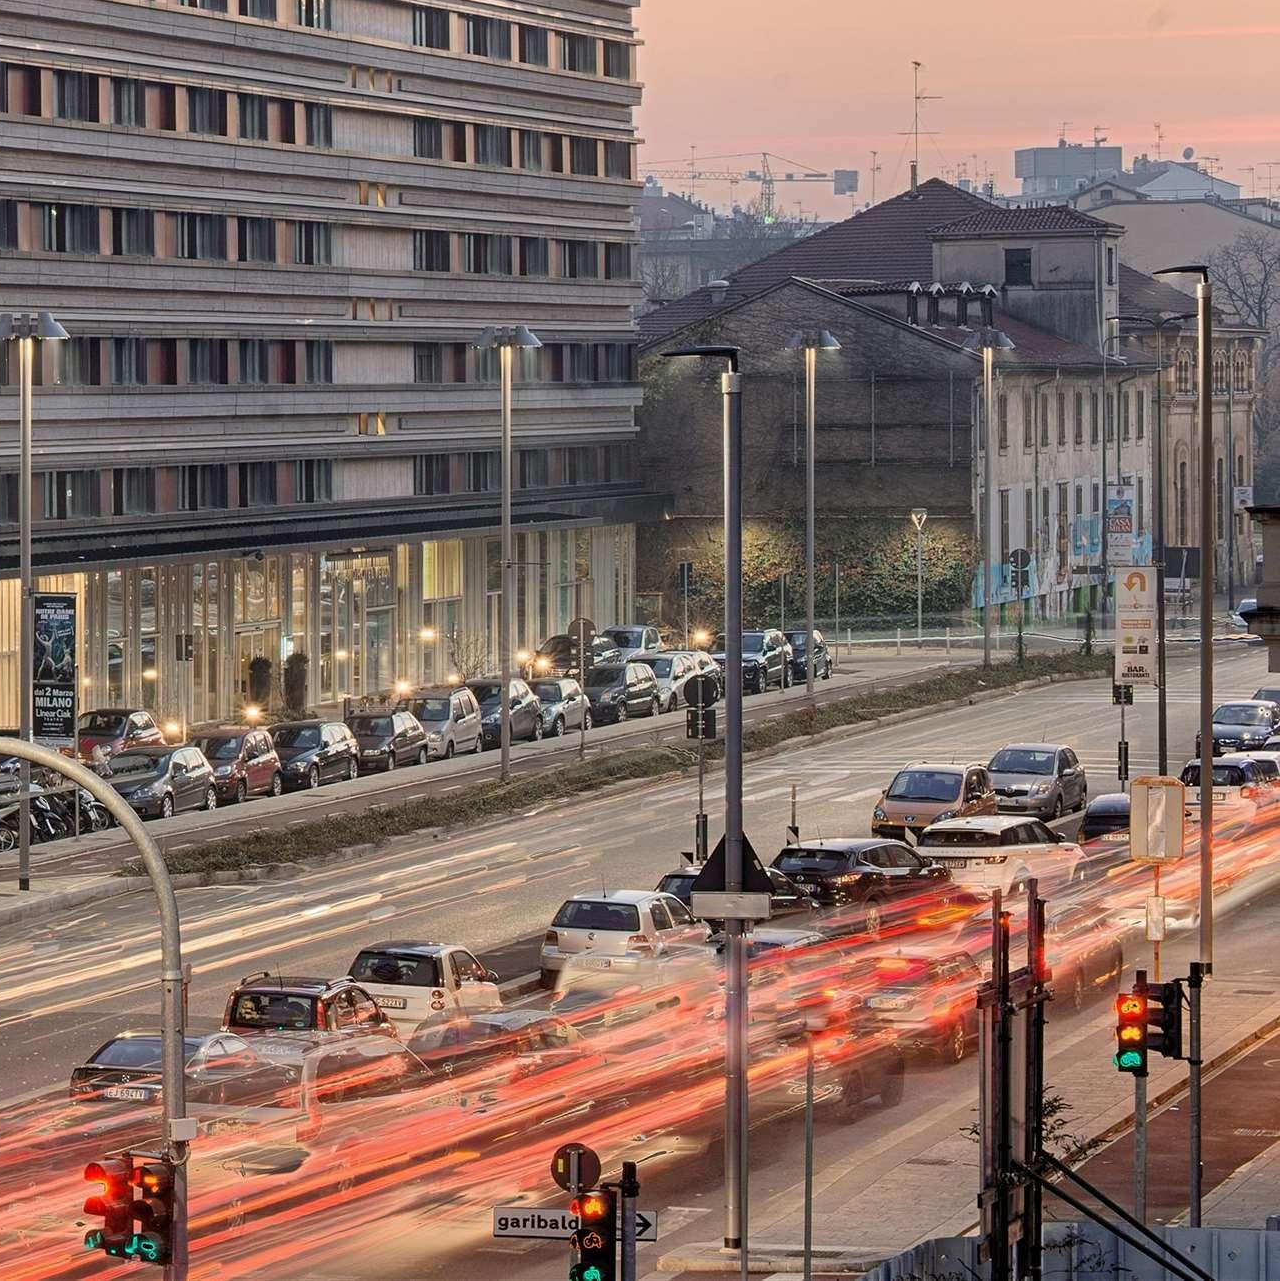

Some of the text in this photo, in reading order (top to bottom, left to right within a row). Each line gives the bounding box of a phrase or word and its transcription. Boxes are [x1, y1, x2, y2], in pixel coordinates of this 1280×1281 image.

[1127, 665, 1145, 673] BAR
[34, 686, 74, 697] dal 2 Marzo
[35, 696, 73, 708] MILANO
